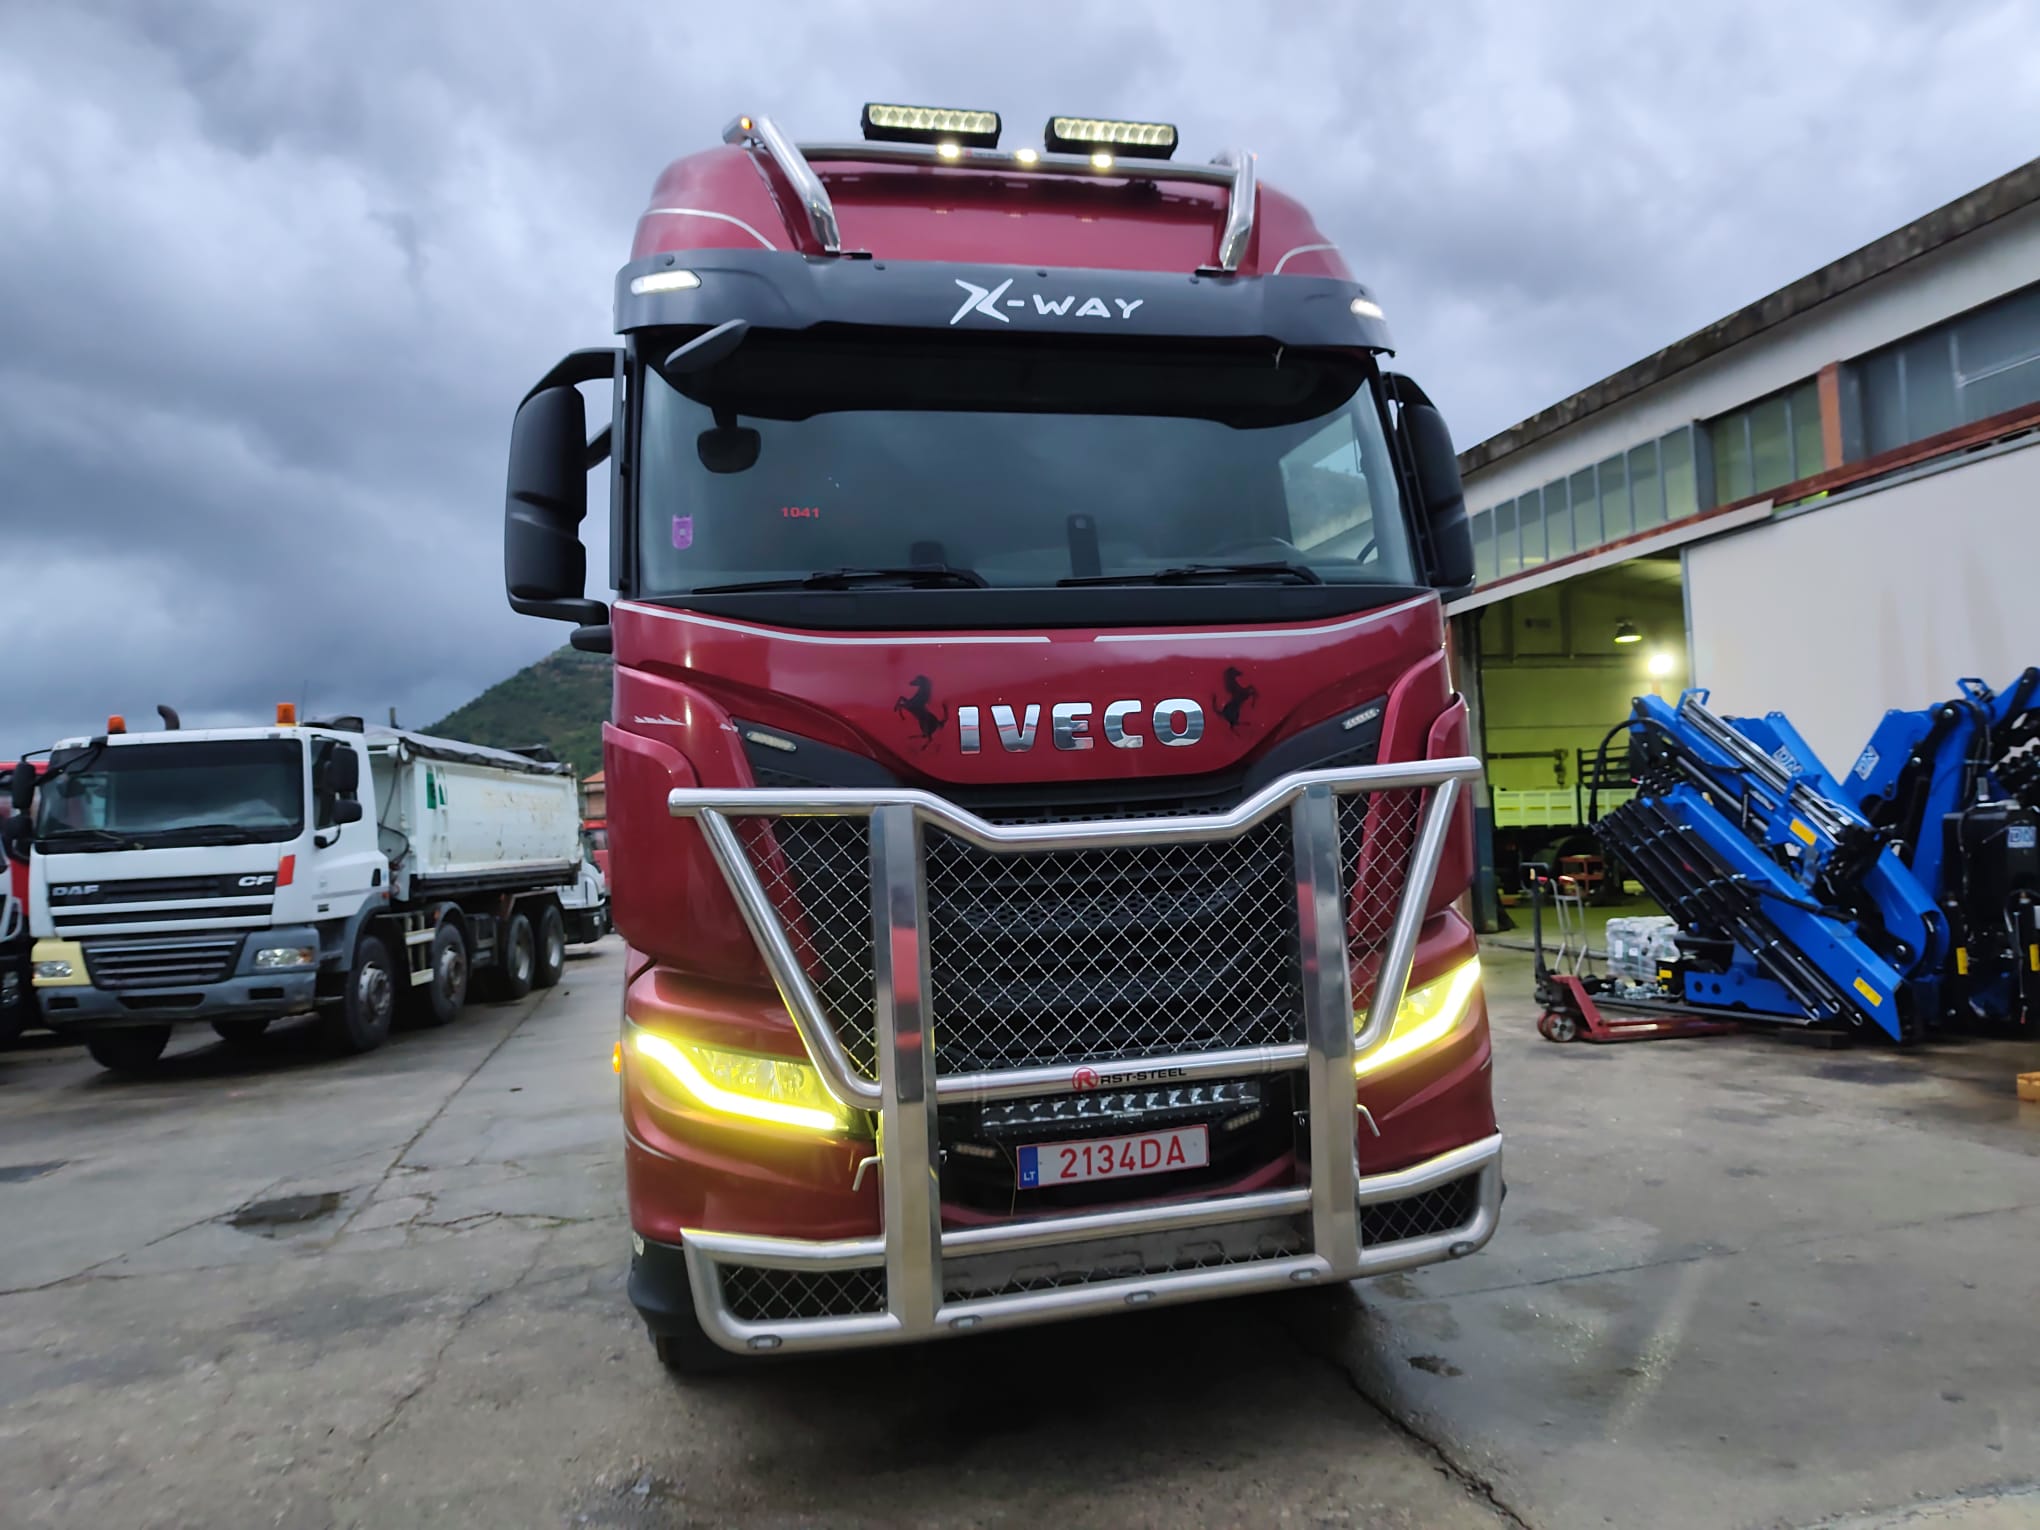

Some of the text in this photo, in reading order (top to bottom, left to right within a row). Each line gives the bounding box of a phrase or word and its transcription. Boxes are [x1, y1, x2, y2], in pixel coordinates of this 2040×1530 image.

[950, 278, 1144, 325] X-WAY
[783, 507, 819, 518] 1041
[958, 698, 1205, 754] IVECO
[238, 875, 275, 887] CF
[52, 884, 99, 897] DAF
[1059, 1134, 1186, 1179] 2134DA
[1023, 1171, 1036, 1181] LT
